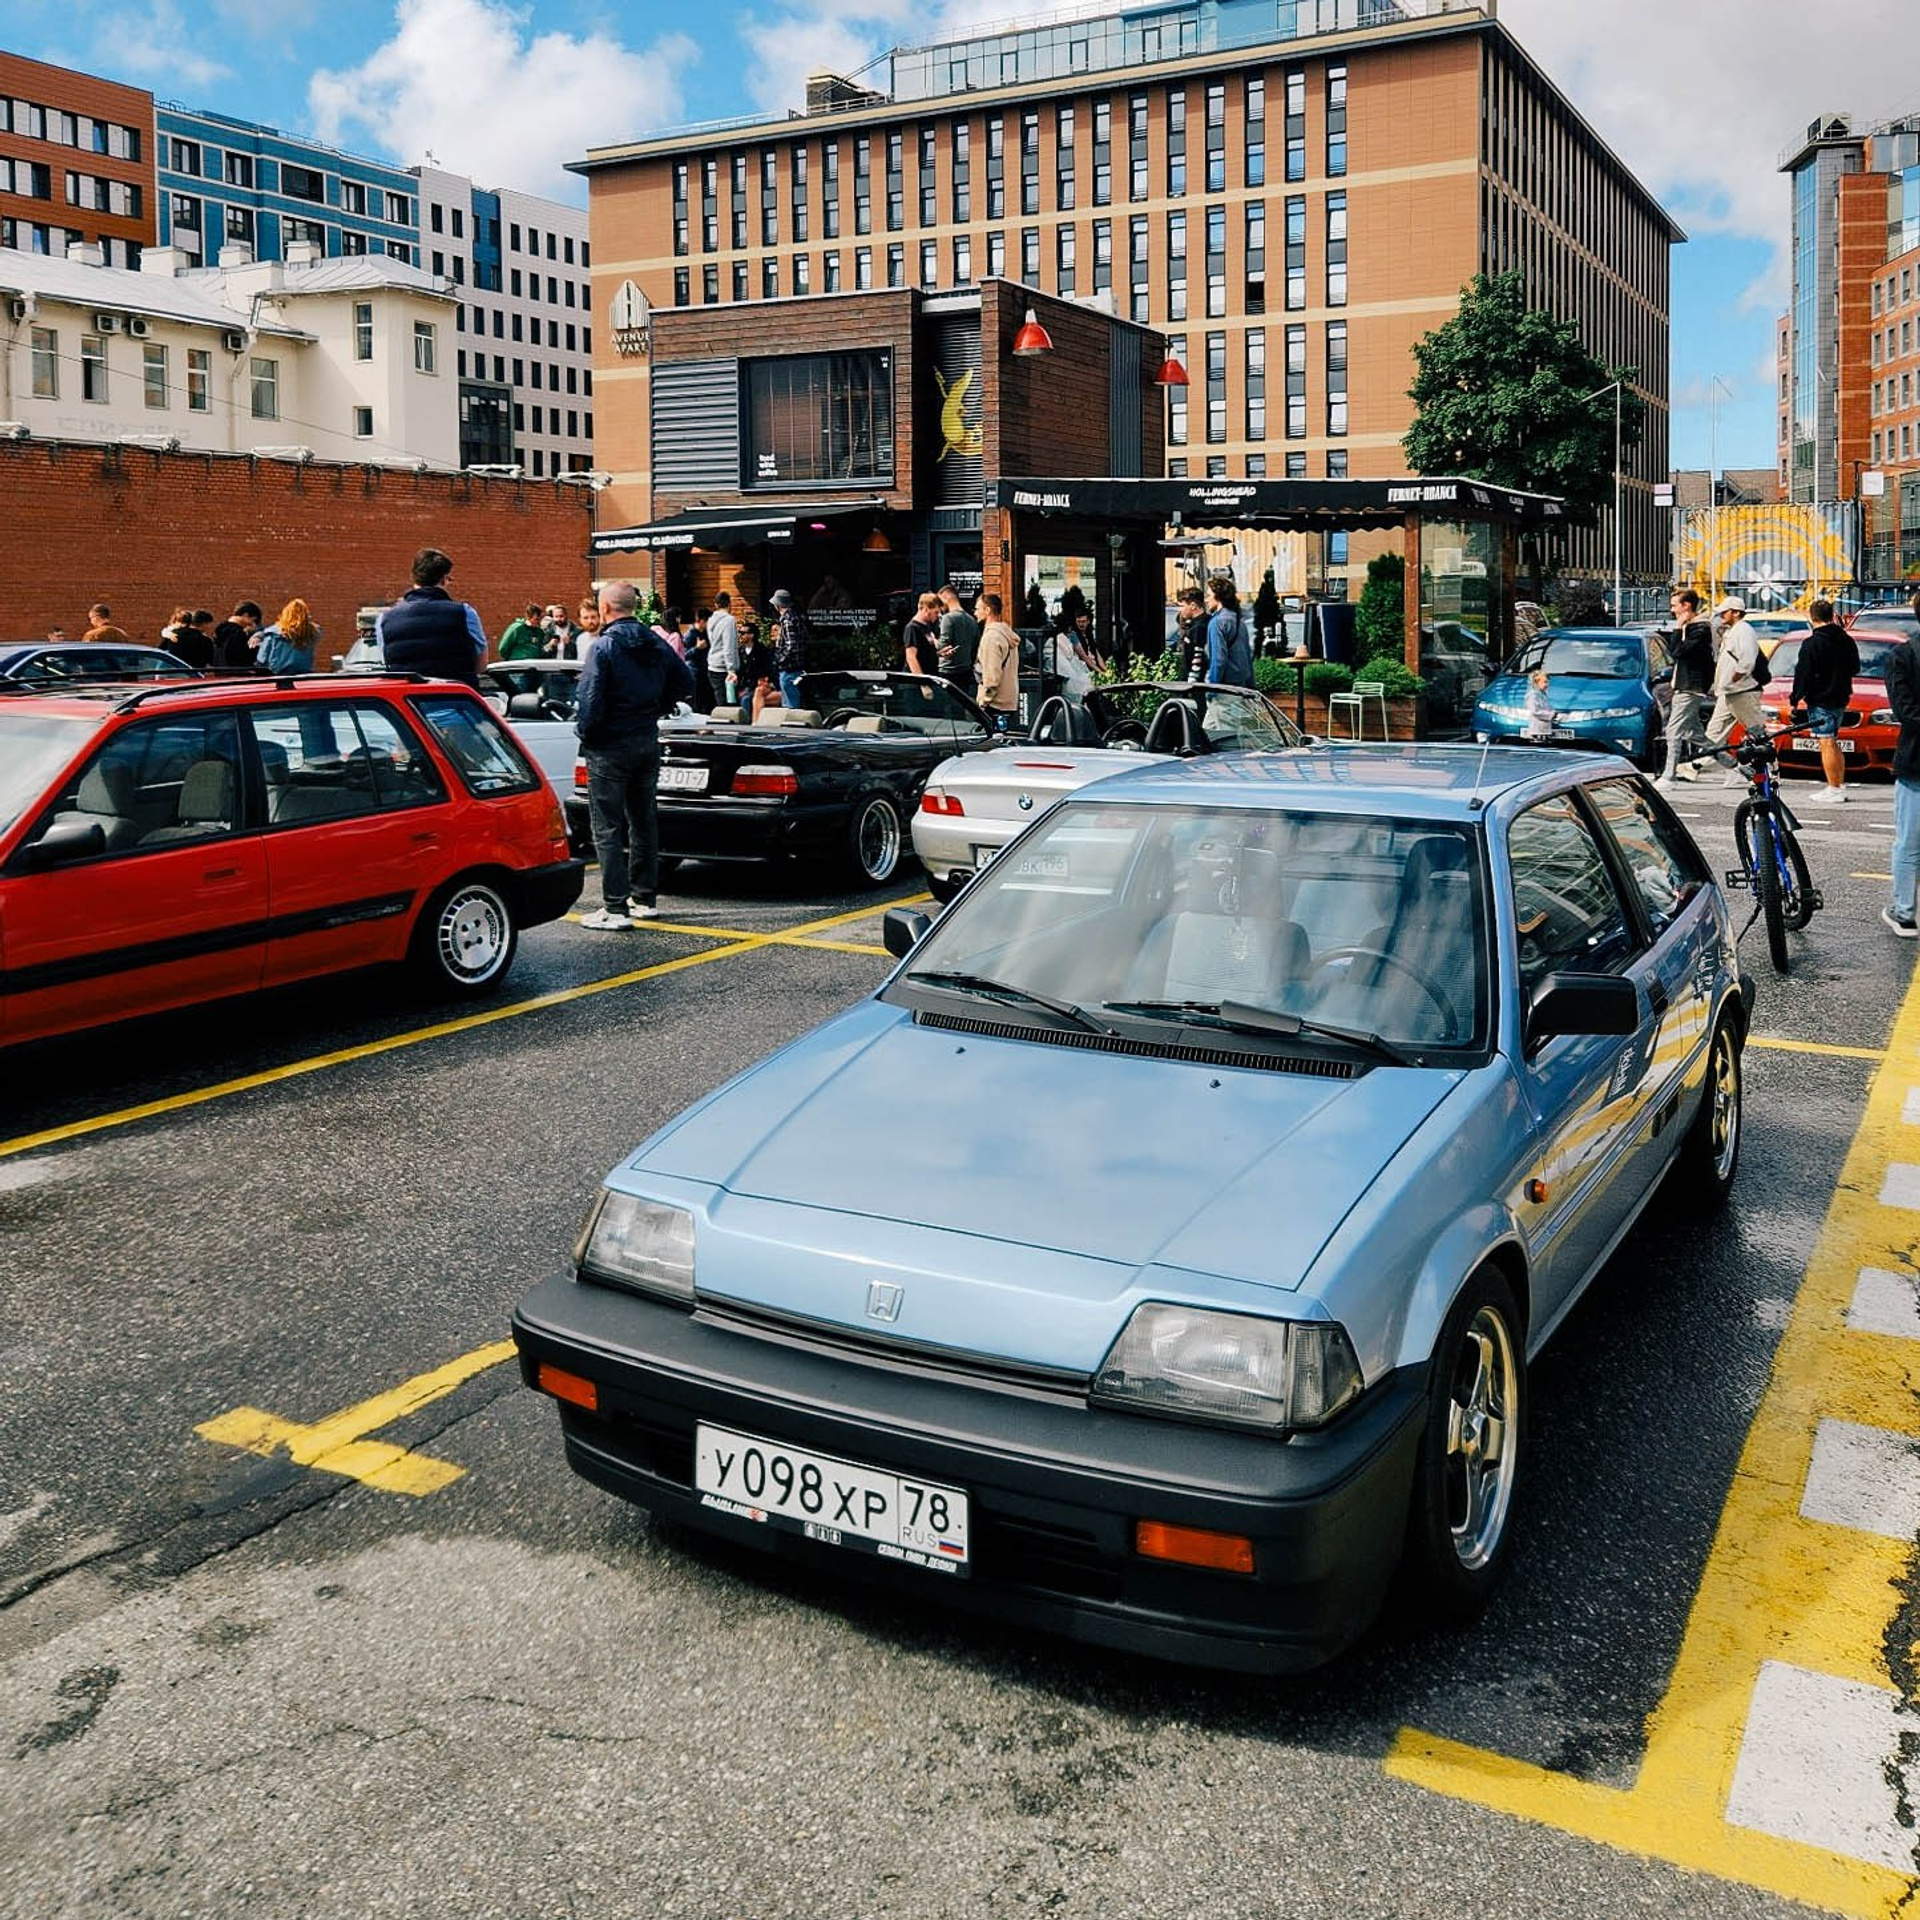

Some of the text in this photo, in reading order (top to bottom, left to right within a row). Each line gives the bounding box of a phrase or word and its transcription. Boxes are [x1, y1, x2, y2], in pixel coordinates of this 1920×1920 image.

[610, 331, 650, 343] AVENUE
[1188, 486, 1257, 497] HOLLINGSHEAD
[1388, 485, 1457, 503] FERNET-BRANCA
[904, 1484, 950, 1534] 78
[902, 1526, 937, 1549] RUS
